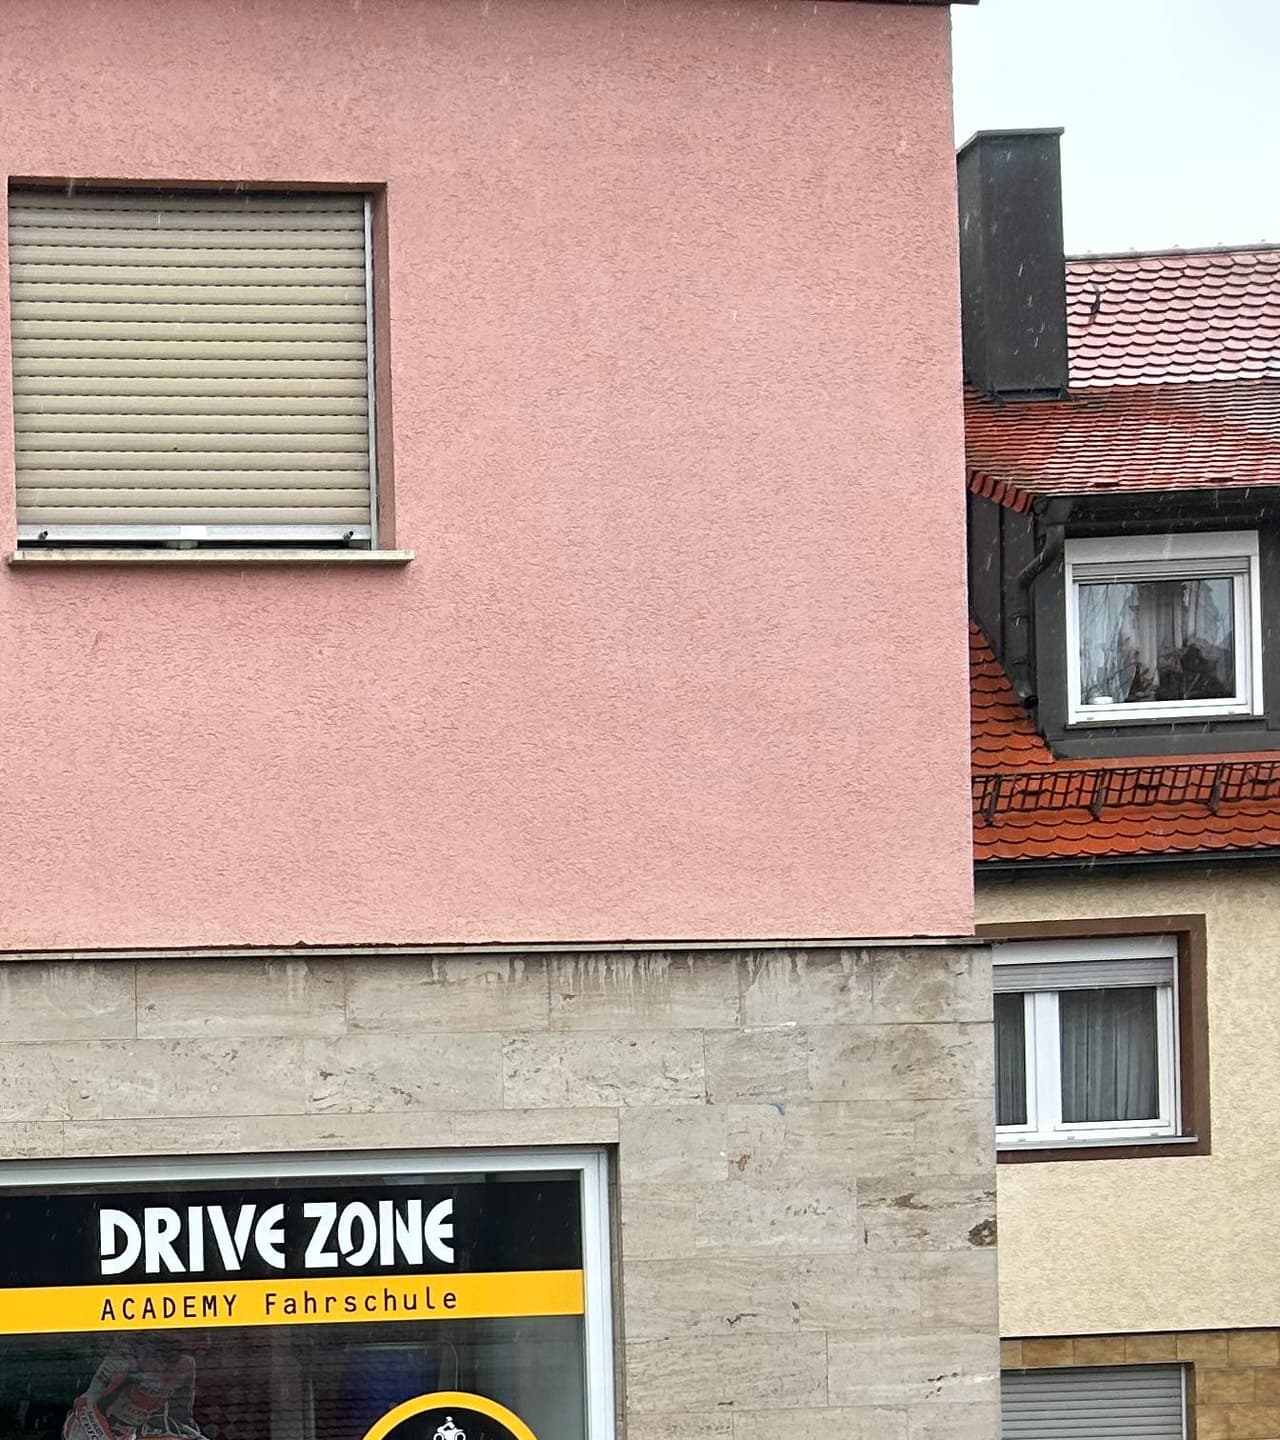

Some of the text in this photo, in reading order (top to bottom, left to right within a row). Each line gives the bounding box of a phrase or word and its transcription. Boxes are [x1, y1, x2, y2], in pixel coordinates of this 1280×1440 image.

[100, 1198, 454, 1275] DRIVE ZONE
[101, 1286, 457, 1321] ACADEMY Fahrschule
